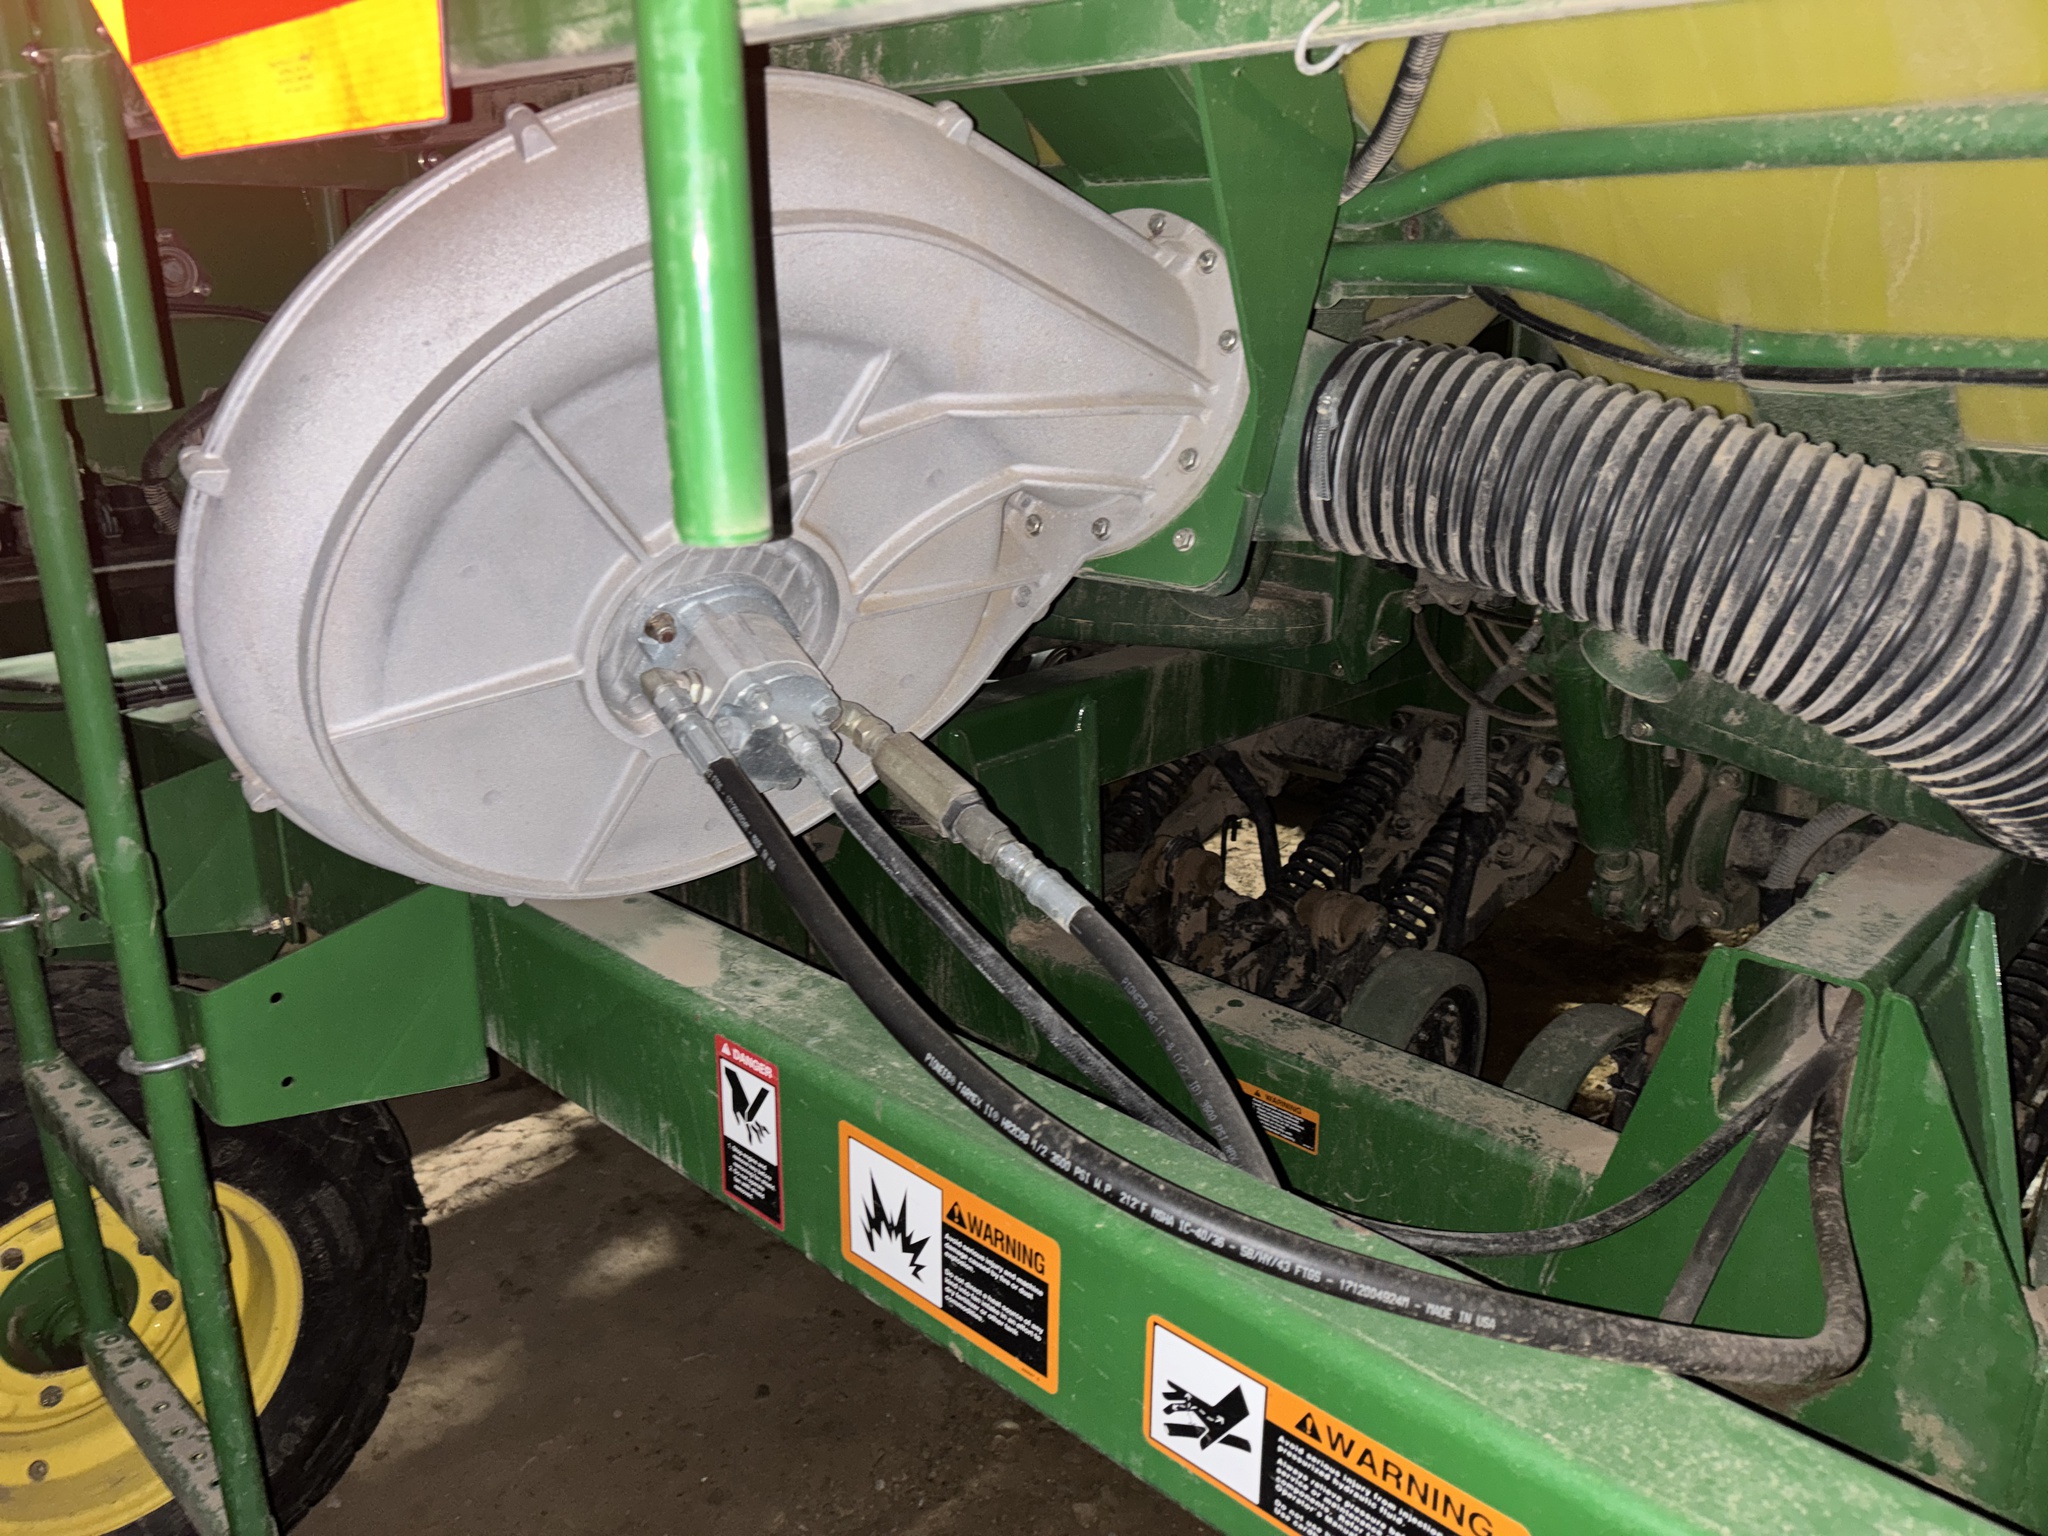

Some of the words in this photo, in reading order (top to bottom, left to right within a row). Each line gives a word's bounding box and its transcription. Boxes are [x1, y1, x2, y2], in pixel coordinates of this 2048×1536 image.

[732, 1048, 774, 1078] DANGER
[1121, 977, 1148, 1010] PIONEER
[1213, 1123, 1229, 1140] PSI
[1264, 1093, 1302, 1115] WARNING
[967, 1211, 1046, 1276] WARNING
[1073, 1165, 1090, 1184] PSI
[1426, 1302, 1453, 1321] MADE
[1459, 1311, 1472, 1325] IN
[1476, 1315, 1497, 1330] USA
[1275, 1484, 1322, 1518] Operator's
[1276, 1467, 1309, 1491] service
[1311, 1488, 1321, 1498] or
[1323, 1494, 1383, 1536] maintenance
[1277, 1446, 1330, 1481] pressurized
[1333, 1478, 1377, 1509] hydraulic
[1277, 1458, 1308, 1482] Always
[1310, 1479, 1342, 1502] relieve
[1344, 1500, 1387, 1530] pressure
[1278, 1435, 1305, 1455] Avoid
[1306, 1453, 1341, 1477] serious
[1343, 1474, 1371, 1496] injury
[1373, 1492, 1396, 1511] from
[1399, 1508, 1444, 1536] injection
[1327, 1425, 1494, 1536] WARNING
[1274, 1506, 1291, 1521] Use
[1274, 1499, 1287, 1510] Do
[1289, 1509, 1304, 1521] not
[1306, 1519, 1322, 1533] use
[1338, 1512, 1364, 1534] Refer
